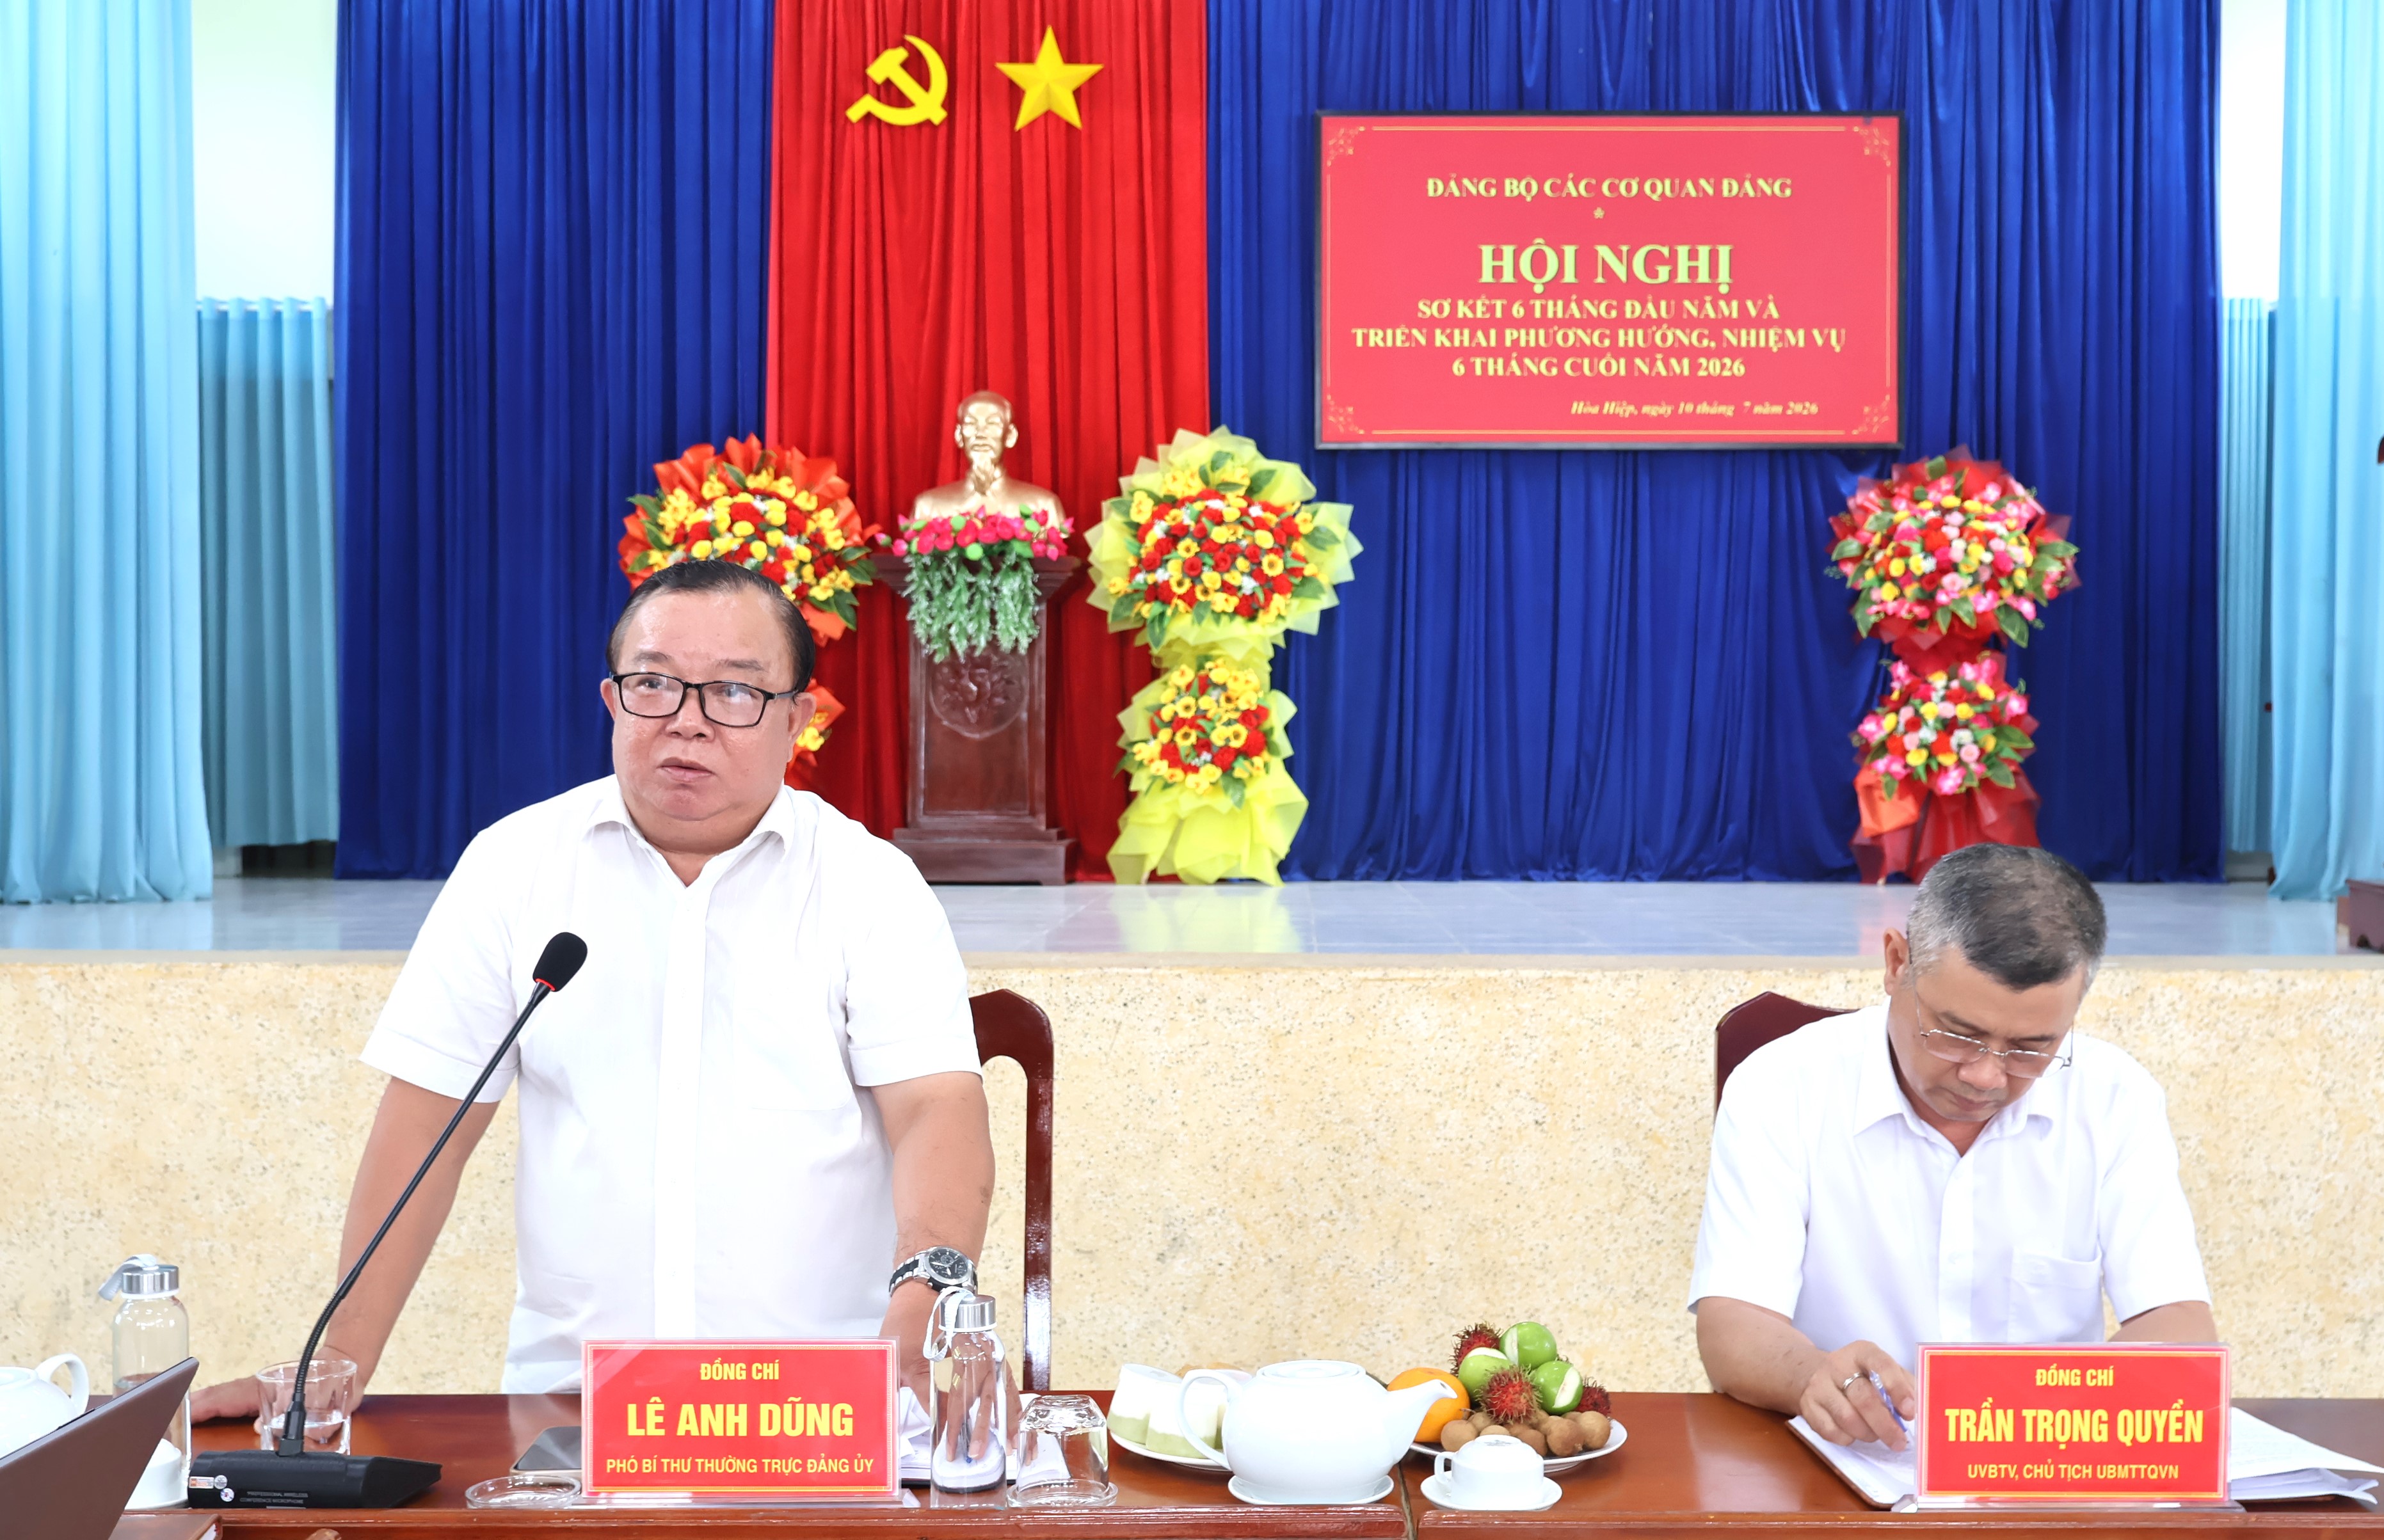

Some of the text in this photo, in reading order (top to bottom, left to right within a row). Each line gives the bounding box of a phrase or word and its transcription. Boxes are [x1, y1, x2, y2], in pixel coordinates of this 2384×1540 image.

[1427, 173, 1792, 202] ĐẢNG BỘ CÁC CƠ QUAN ĐẢNG
[1478, 237, 1734, 294] HỘI NGHỊ
[1418, 294, 1780, 319] SƠ KẾT 6 THÁNG ĐẦU NĂM VÀ
[1434, 328, 1496, 347] KHAI
[1505, 326, 1610, 347] PHƯƠNG
[1618, 323, 1716, 350] HƯỚNG,
[1722, 326, 1805, 353] NHIỆM
[1811, 328, 1846, 353] VỤ
[1452, 352, 1745, 377] 6 THÁNG CUỐI NĂM 2026
[1743, 401, 1752, 415] 7
[700, 1358, 779, 1380] ĐỒNG CHÍ
[2035, 1363, 2113, 1386] ĐỒNG CHÍ
[627, 1397, 853, 1436] LÊ ANH DŨNG
[2022, 1409, 2108, 1450] TRỌNG
[607, 1453, 874, 1475] PHÓ BÍ THƯ THƯỜNG TRỰC ĐẢNG ỦY
[1968, 1459, 2179, 1481] UVBTV, CHỦ TỊCH UBMTTQVN
